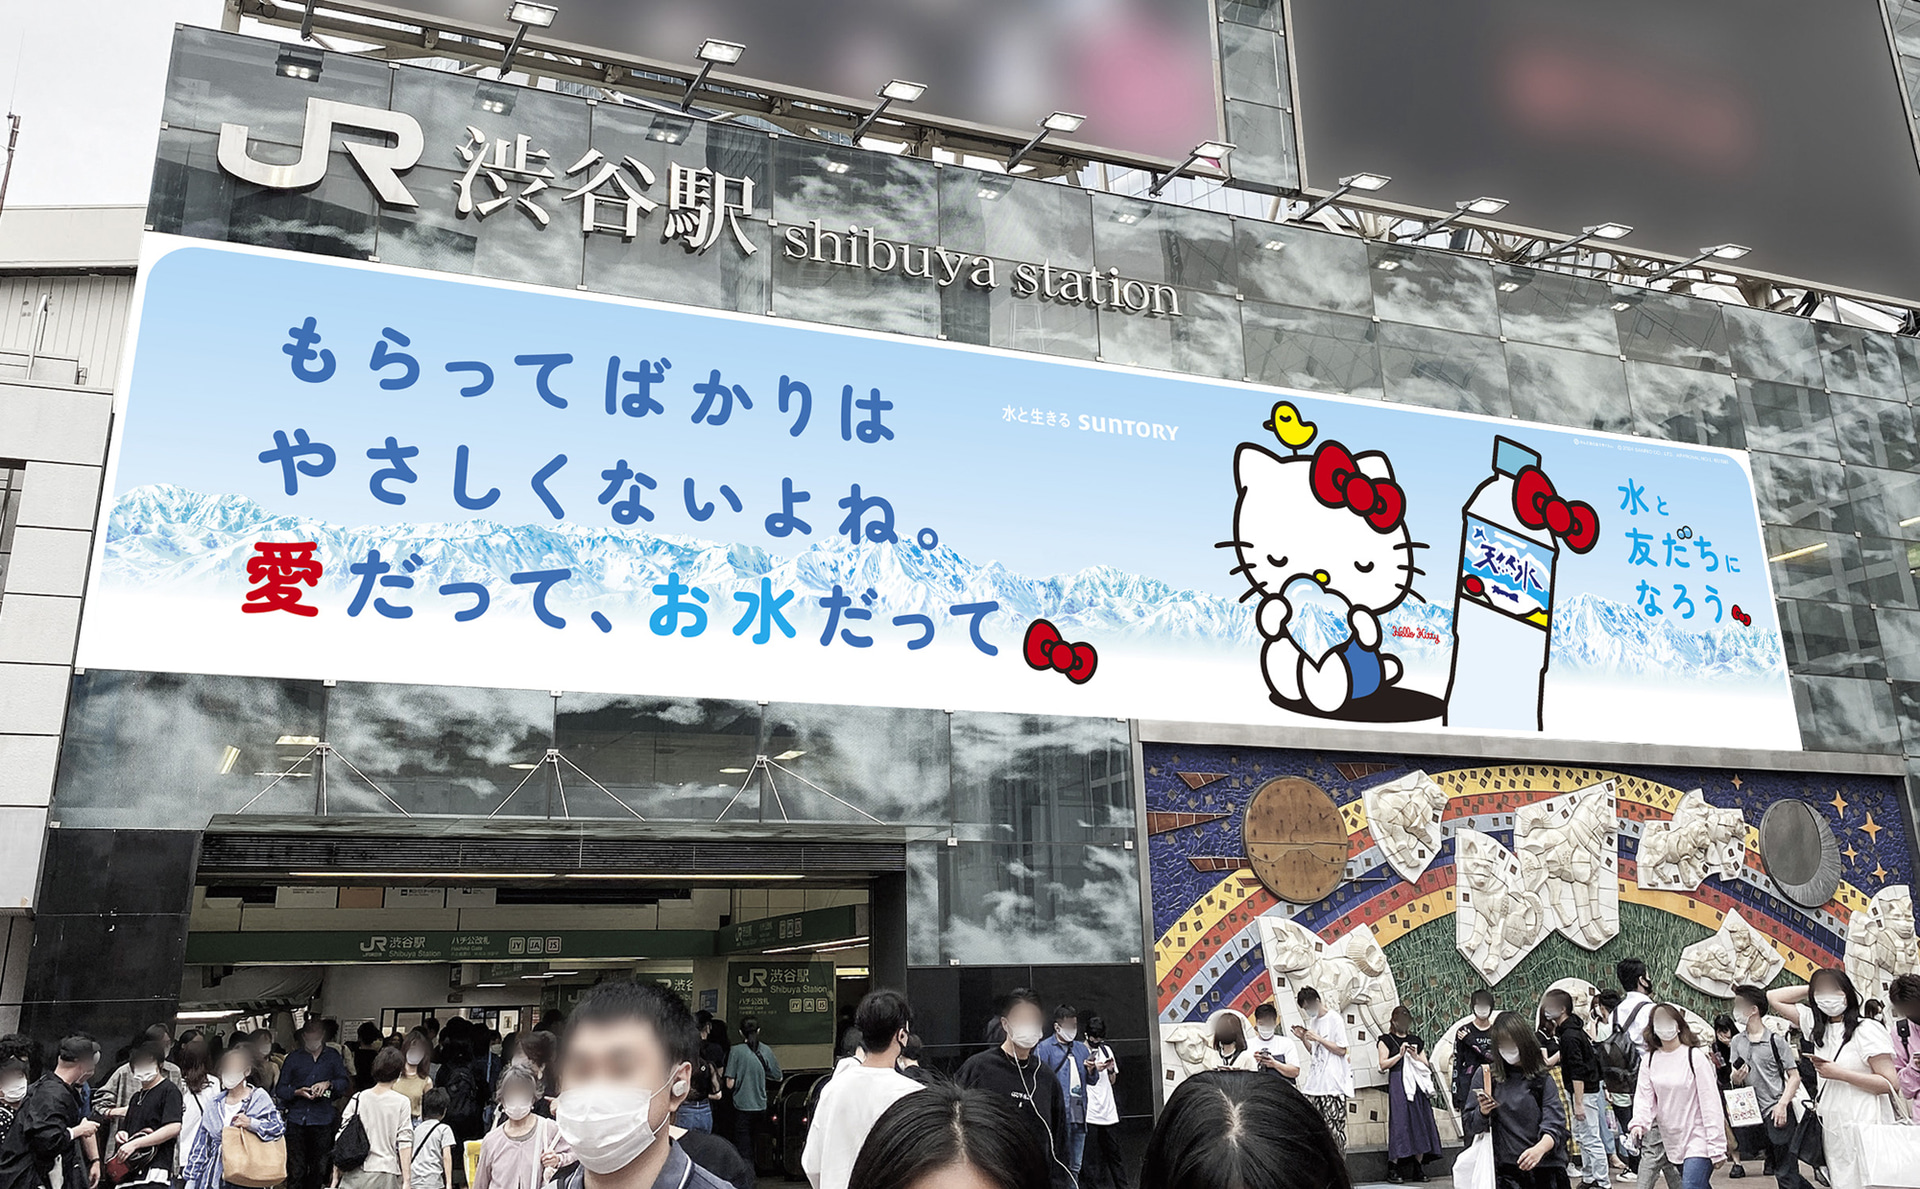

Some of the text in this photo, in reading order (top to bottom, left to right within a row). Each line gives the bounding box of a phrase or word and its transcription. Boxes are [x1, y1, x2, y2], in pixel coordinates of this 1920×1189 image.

[216, 97, 759, 257] JR 渋谷駅
[783, 219, 1182, 316] shibuya station
[282, 316, 895, 444] もらってばかりは
[1002, 404, 1179, 441] 水と生きる SUNTORY
[258, 428, 939, 551] やさしくないよね。
[1617, 477, 1669, 516] 水と
[1473, 543, 1543, 592] 天然水
[1624, 526, 1741, 573] 友だちに
[241, 541, 1000, 657] 愛だって、お水だって
[1635, 579, 1723, 624] なろう
[1392, 625, 1440, 645] Hello Kitty
[360, 936, 426, 952] JR 渋谷駅
[389, 950, 416, 959] Shibuya
[418, 950, 441, 958] Station
[737, 968, 809, 987] JR 渋谷駅
[769, 985, 801, 995] Shibuya
[802, 984, 828, 994] Station
